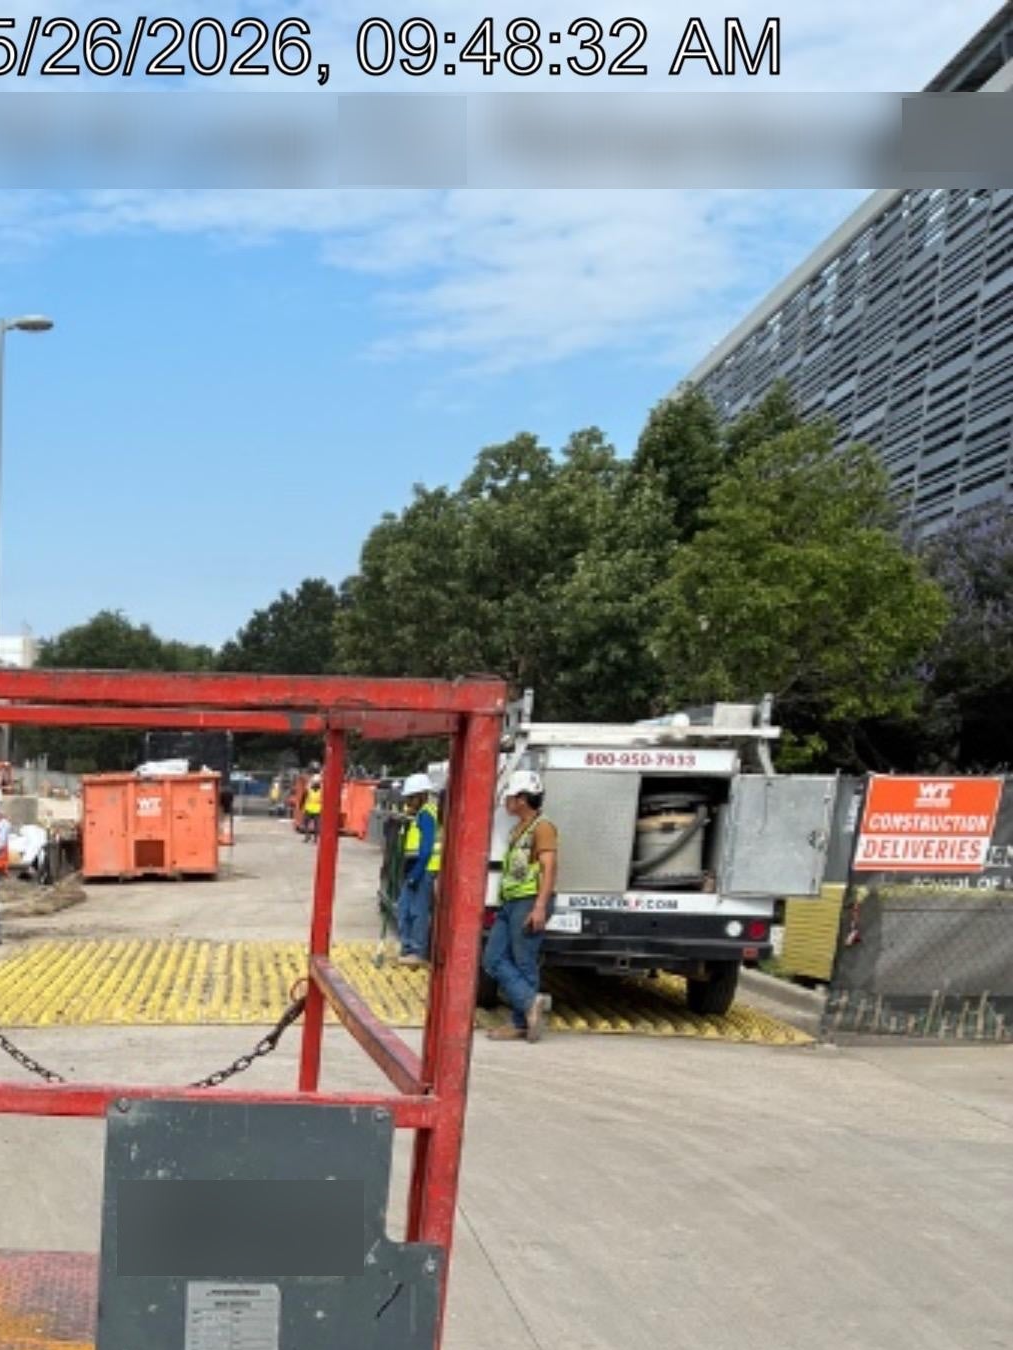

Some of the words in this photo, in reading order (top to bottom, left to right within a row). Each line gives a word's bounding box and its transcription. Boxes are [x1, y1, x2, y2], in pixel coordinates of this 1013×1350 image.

[919, 783, 955, 799] WT
[868, 812, 990, 832] CONSTRUCTION
[862, 839, 982, 860] DELIVERIES
